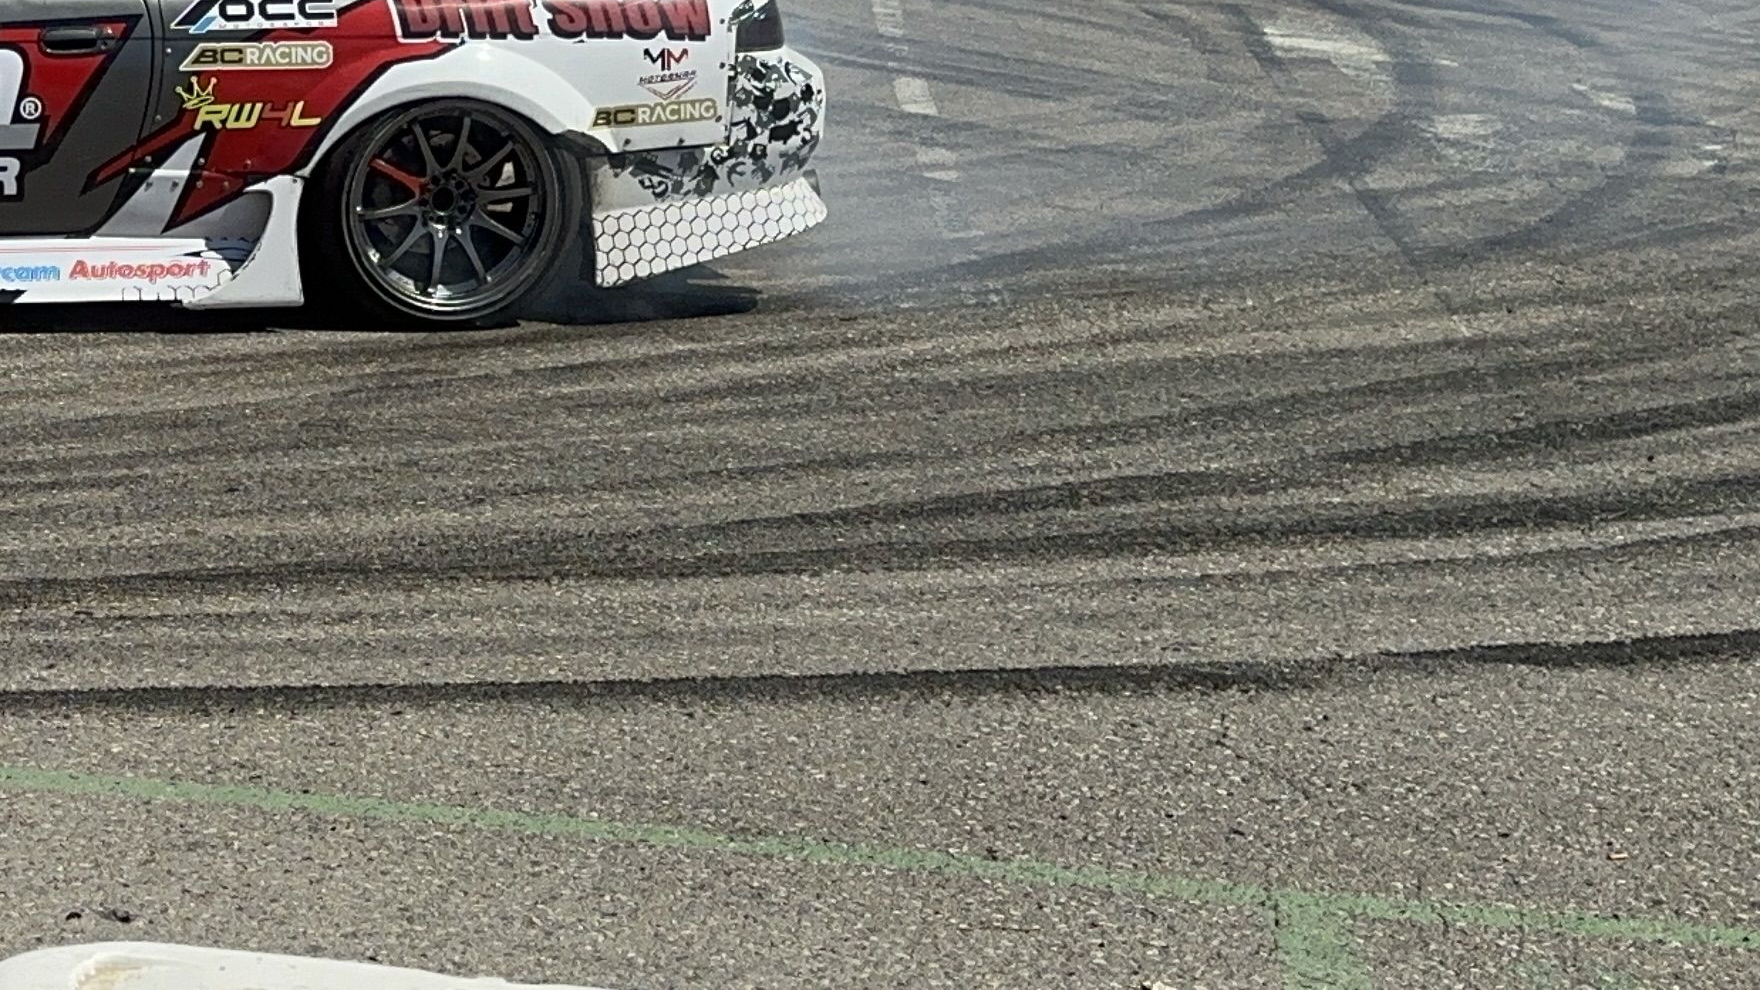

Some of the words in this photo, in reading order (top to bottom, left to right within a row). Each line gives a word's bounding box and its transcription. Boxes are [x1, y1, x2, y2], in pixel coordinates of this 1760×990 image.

[246, 44, 329, 65] RACING
[637, 101, 715, 123] RACING
[68, 259, 212, 284] Autosport
